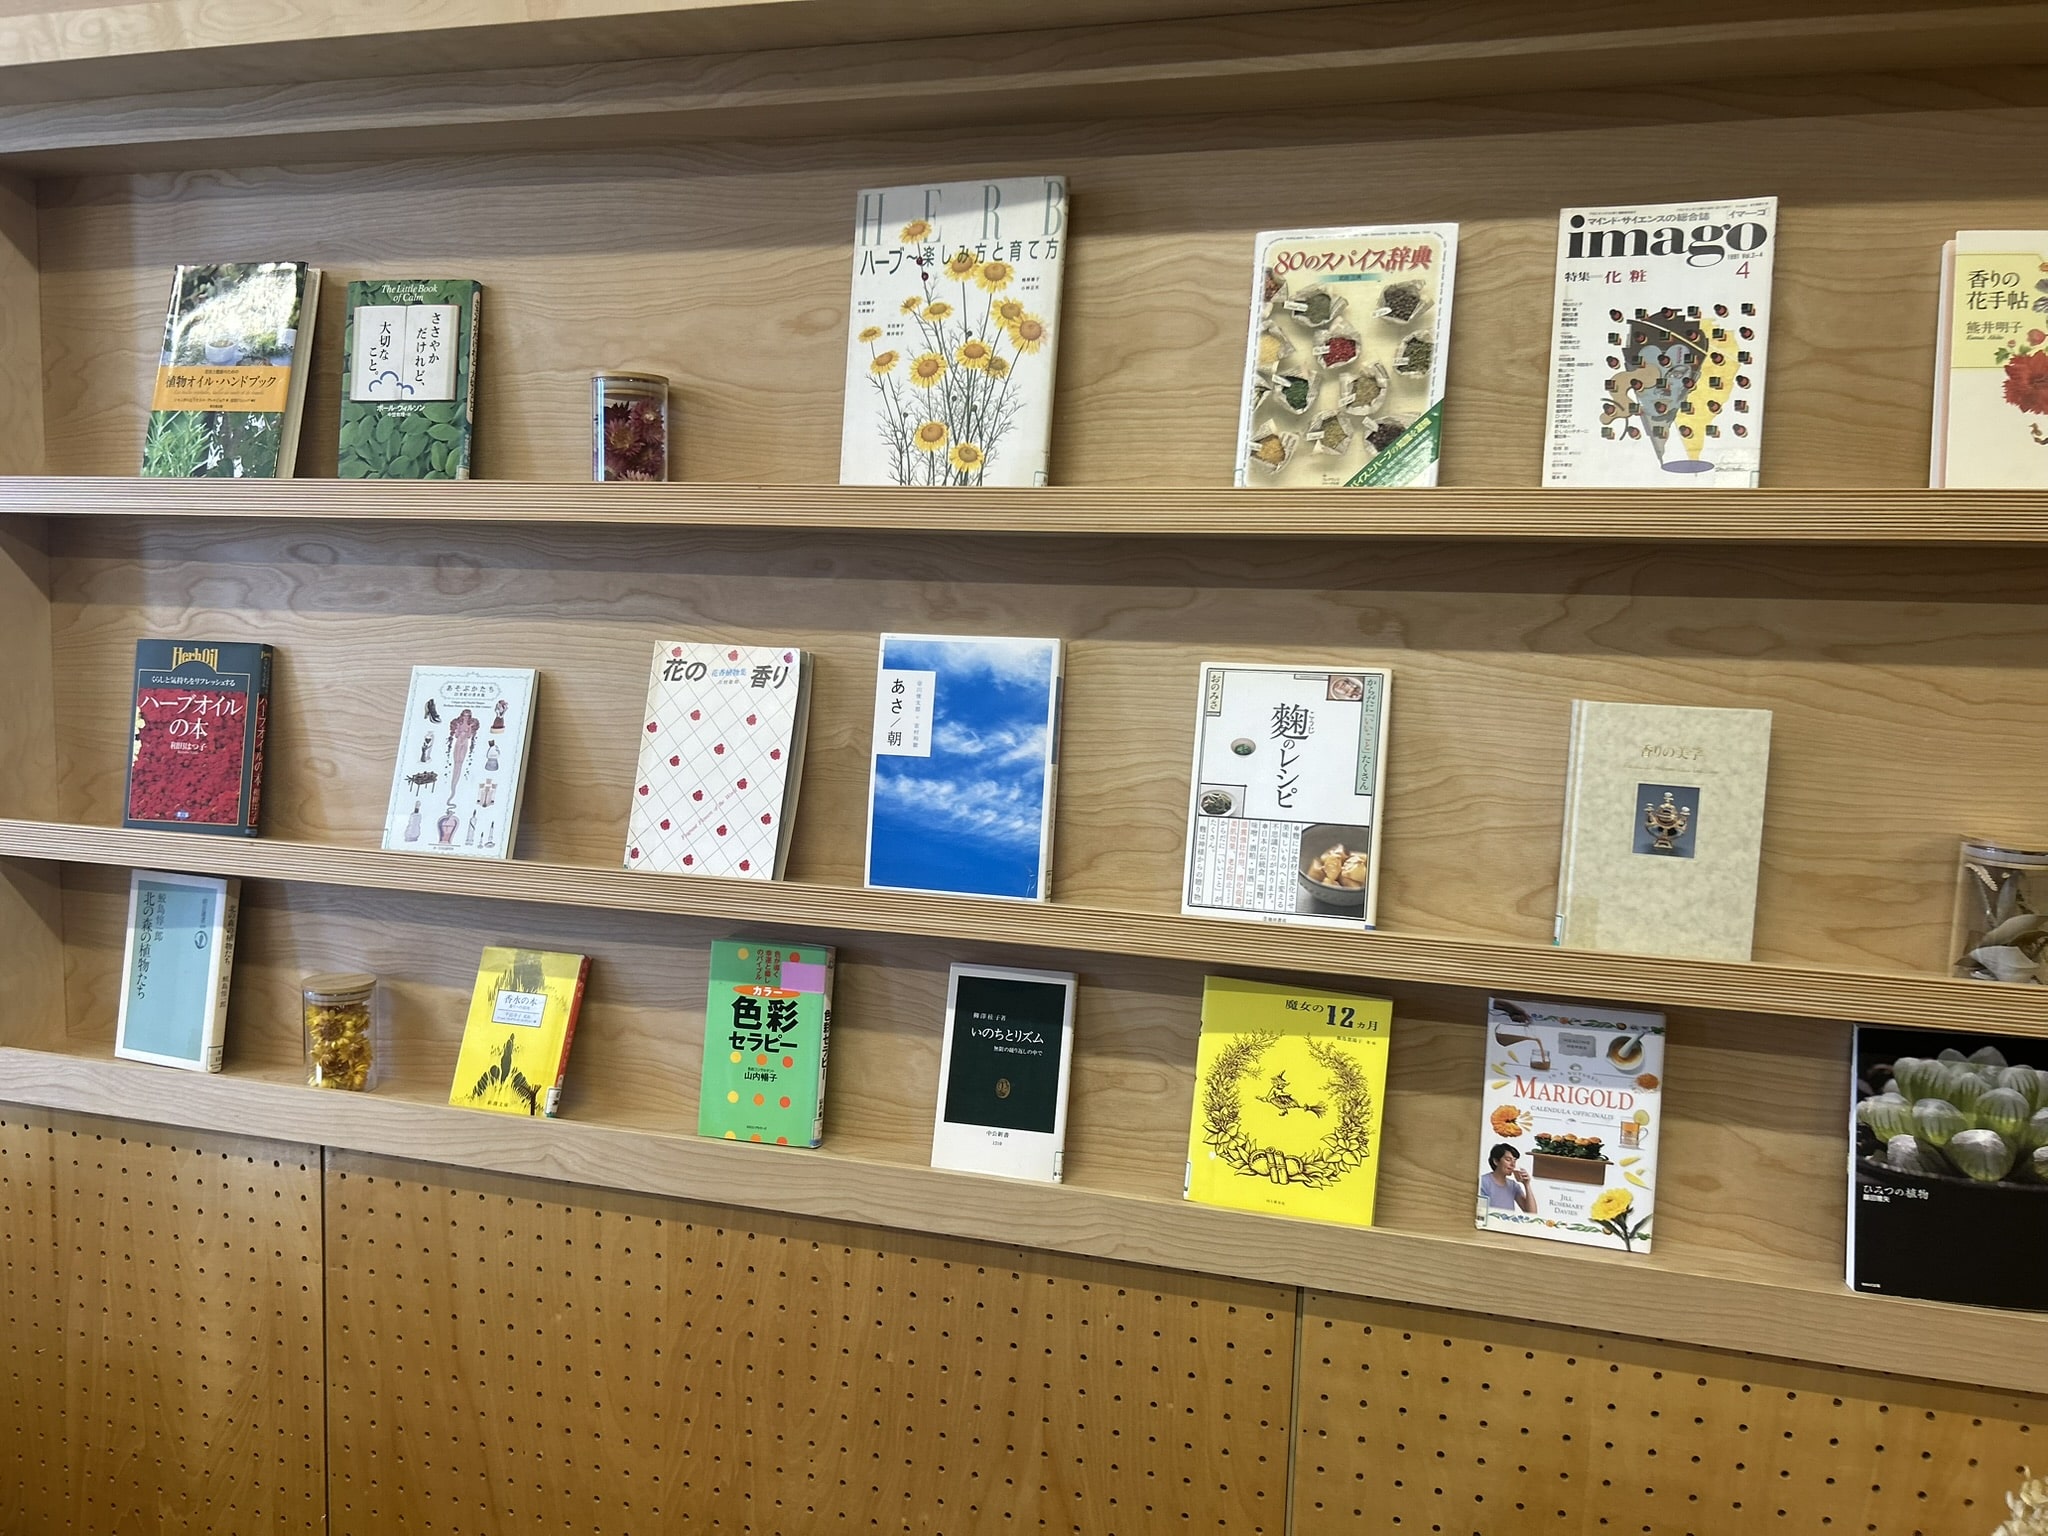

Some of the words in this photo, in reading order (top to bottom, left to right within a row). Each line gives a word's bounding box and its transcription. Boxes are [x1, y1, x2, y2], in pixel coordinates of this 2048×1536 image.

[861, 179, 1064, 246] HERB
[1587, 212, 1711, 226] マインド・サイエンスの総合誌
[1565, 214, 1768, 268] imago
[1273, 245, 1433, 275] 80のスパイス辞典
[1735, 261, 1751, 279] 4
[381, 284, 396, 293] The
[396, 284, 417, 293] Little
[418, 284, 438, 293] Book
[1967, 269, 2021, 289] 香りの
[393, 293, 402, 303] of
[402, 293, 425, 301] Calm
[1966, 291, 2030, 310] 花手帖
[428, 312, 441, 364] ささやか
[1966, 321, 2024, 334] 熊井明子
[379, 321, 391, 361] 大切な
[368, 347, 379, 375] こと。
[414, 327, 428, 386] だけれど、
[165, 375, 277, 388] 植物オイル・ハンドブック
[663, 658, 708, 682] 花の
[750, 665, 790, 689] 香り
[1210, 674, 1222, 710] おのみさ
[140, 694, 244, 717] ハーブオイル
[169, 717, 209, 740] の本
[1307, 710, 1316, 735] こうじ
[136, 891, 156, 1000] 北の森の植物たち
[752, 986, 783, 997] カラー
[731, 995, 799, 1034] 色彩
[728, 1031, 798, 1053] セラピー
[971, 1027, 1044, 1044] いのちとリズム
[1513, 1074, 1635, 1111] MARIGOLD
[1530, 1105, 1572, 1116] CALENDULA
[1862, 1184, 1930, 1200] ひみつの植物
